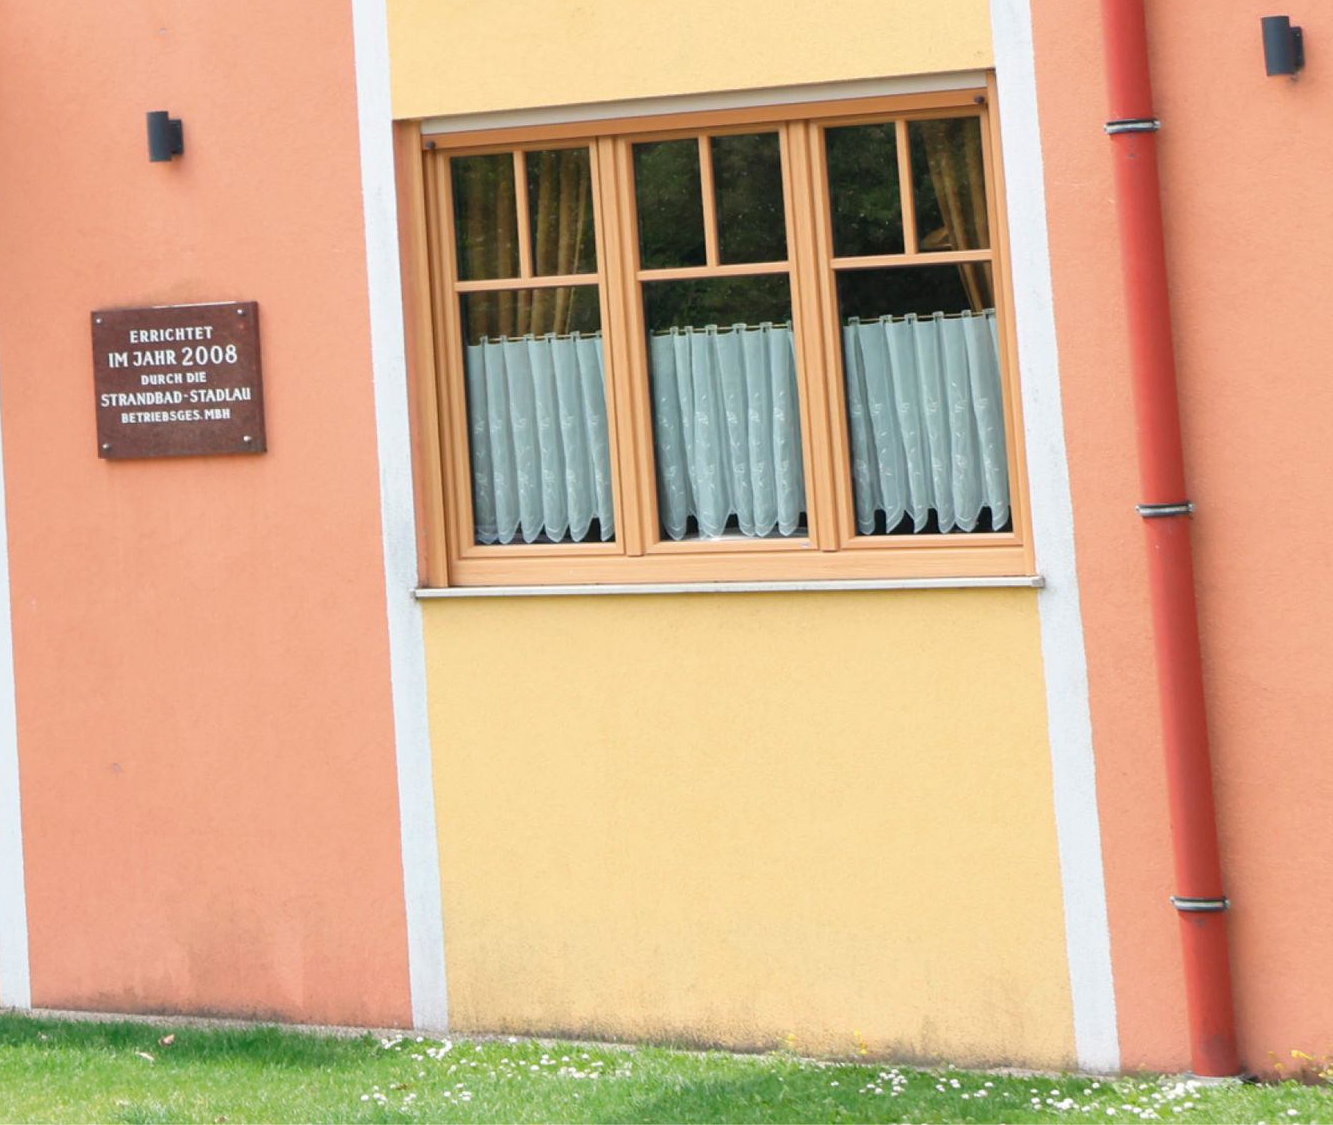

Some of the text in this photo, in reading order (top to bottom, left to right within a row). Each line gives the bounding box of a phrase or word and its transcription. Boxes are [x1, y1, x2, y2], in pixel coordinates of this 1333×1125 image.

[129, 326, 214, 344] ERRICHTET
[108, 344, 238, 368] IM JAHR 2008
[140, 371, 208, 386] DURCH DIE
[100, 386, 252, 408] STRANDBAD-STADLAU
[204, 407, 231, 421] MBH
